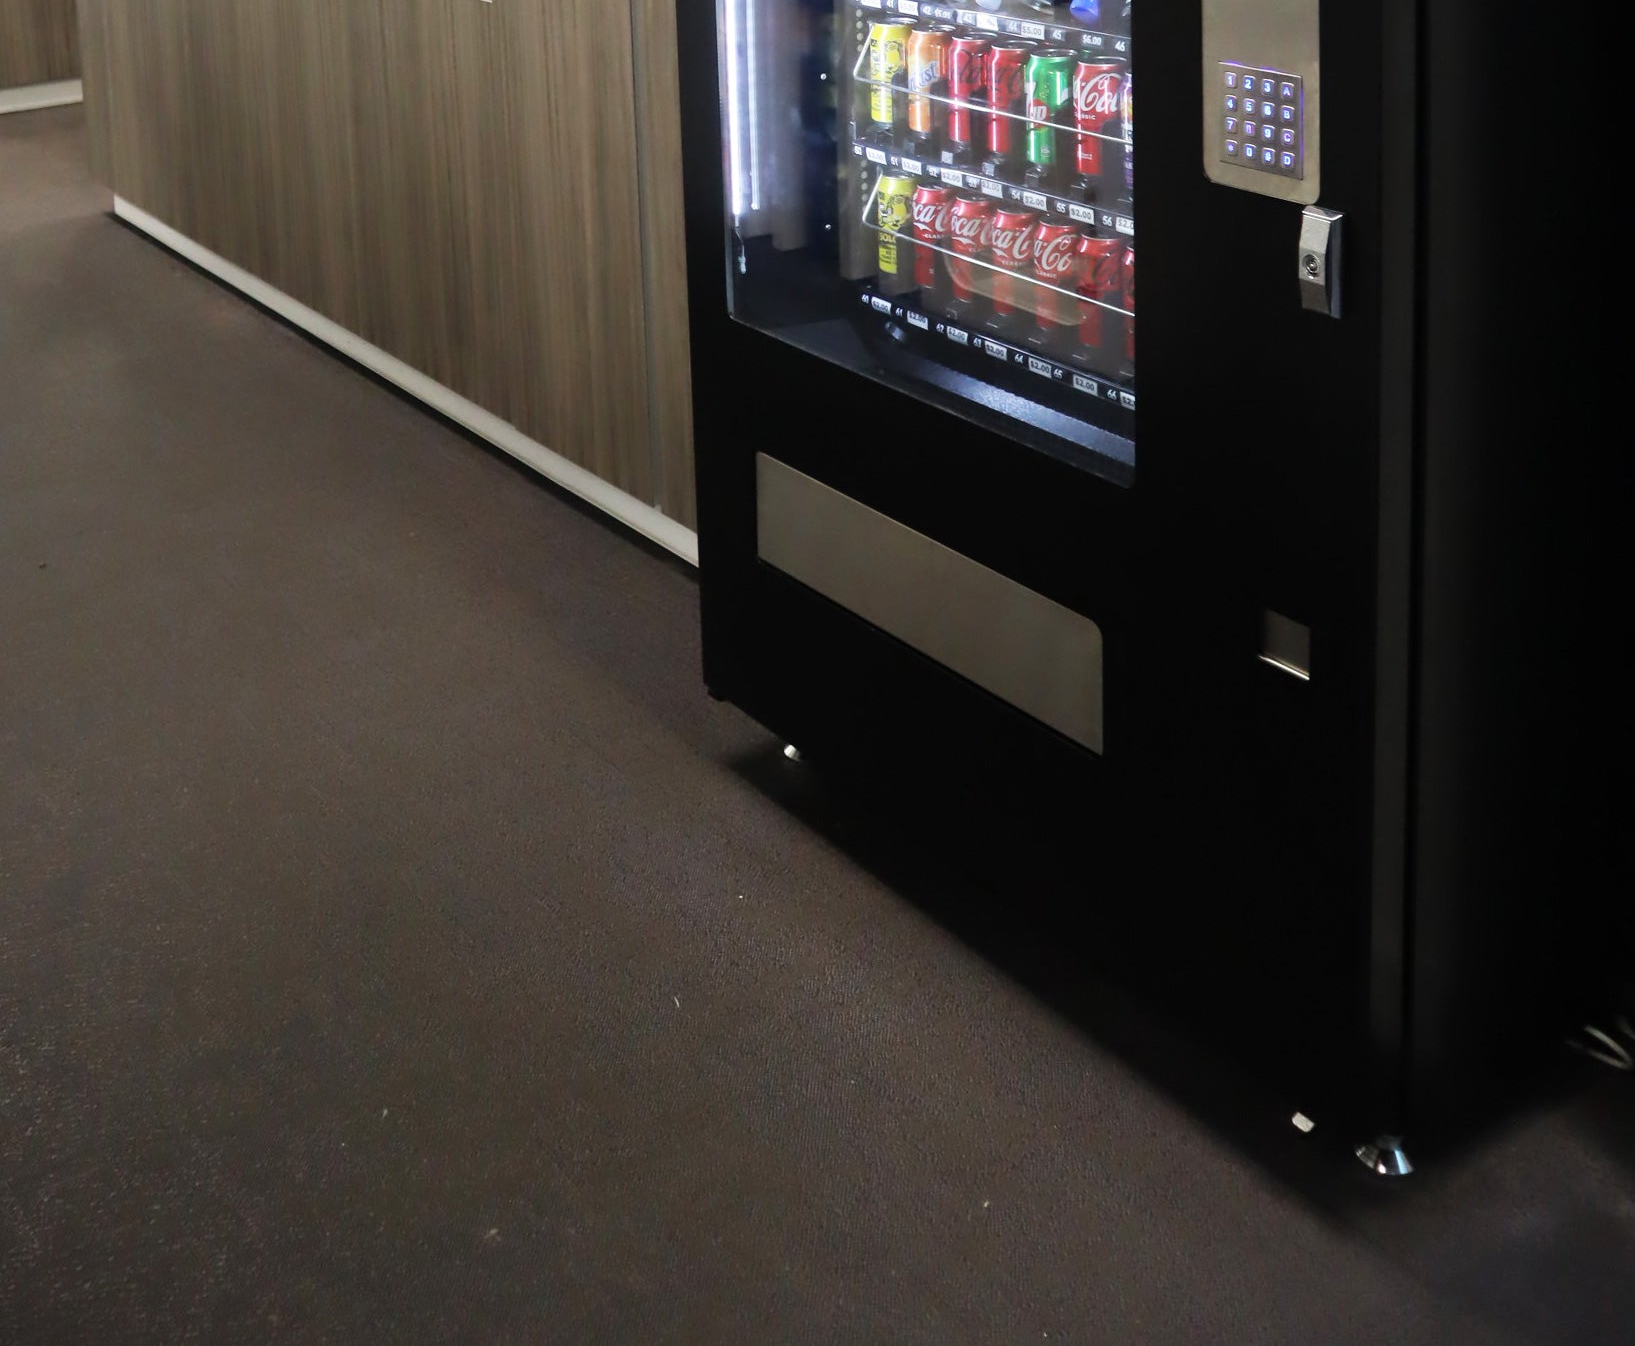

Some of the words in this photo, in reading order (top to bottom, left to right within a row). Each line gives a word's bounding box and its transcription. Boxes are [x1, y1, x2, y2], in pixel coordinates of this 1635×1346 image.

[1022, 25, 1042, 35] $5.00
[1052, 29, 1062, 39] 45
[1082, 34, 1102, 45] $6.00
[1115, 41, 1125, 51] 46
[1228, 75, 1233, 85] 1
[1245, 79, 1252, 89] 2
[1264, 82, 1271, 92] 3
[1283, 87, 1291, 96] A
[1227, 99, 1233, 109] 4
[1246, 102, 1252, 112] 5
[1284, 110, 1290, 119] B
[1227, 121, 1233, 130] 7
[1264, 128, 1271, 138] 9
[1284, 133, 1290, 142] C
[1246, 148, 1252, 157] 0
[1284, 156, 1290, 165] D
[1025, 195, 1045, 207] $2.00
[1056, 202, 1066, 213] 55
[1071, 208, 1091, 220] $2.00
[1102, 216, 1112, 226] 56
[936, 323, 944, 333] 62
[949, 327, 965, 341] $2.00
[987, 344, 1004, 356] $2.00
[1015, 353, 1023, 363] 64
[1030, 359, 1050, 373] $2.00
[1054, 368, 1063, 378] 65
[1075, 378, 1095, 391] $2.00
[1107, 389, 1117, 400] 66
